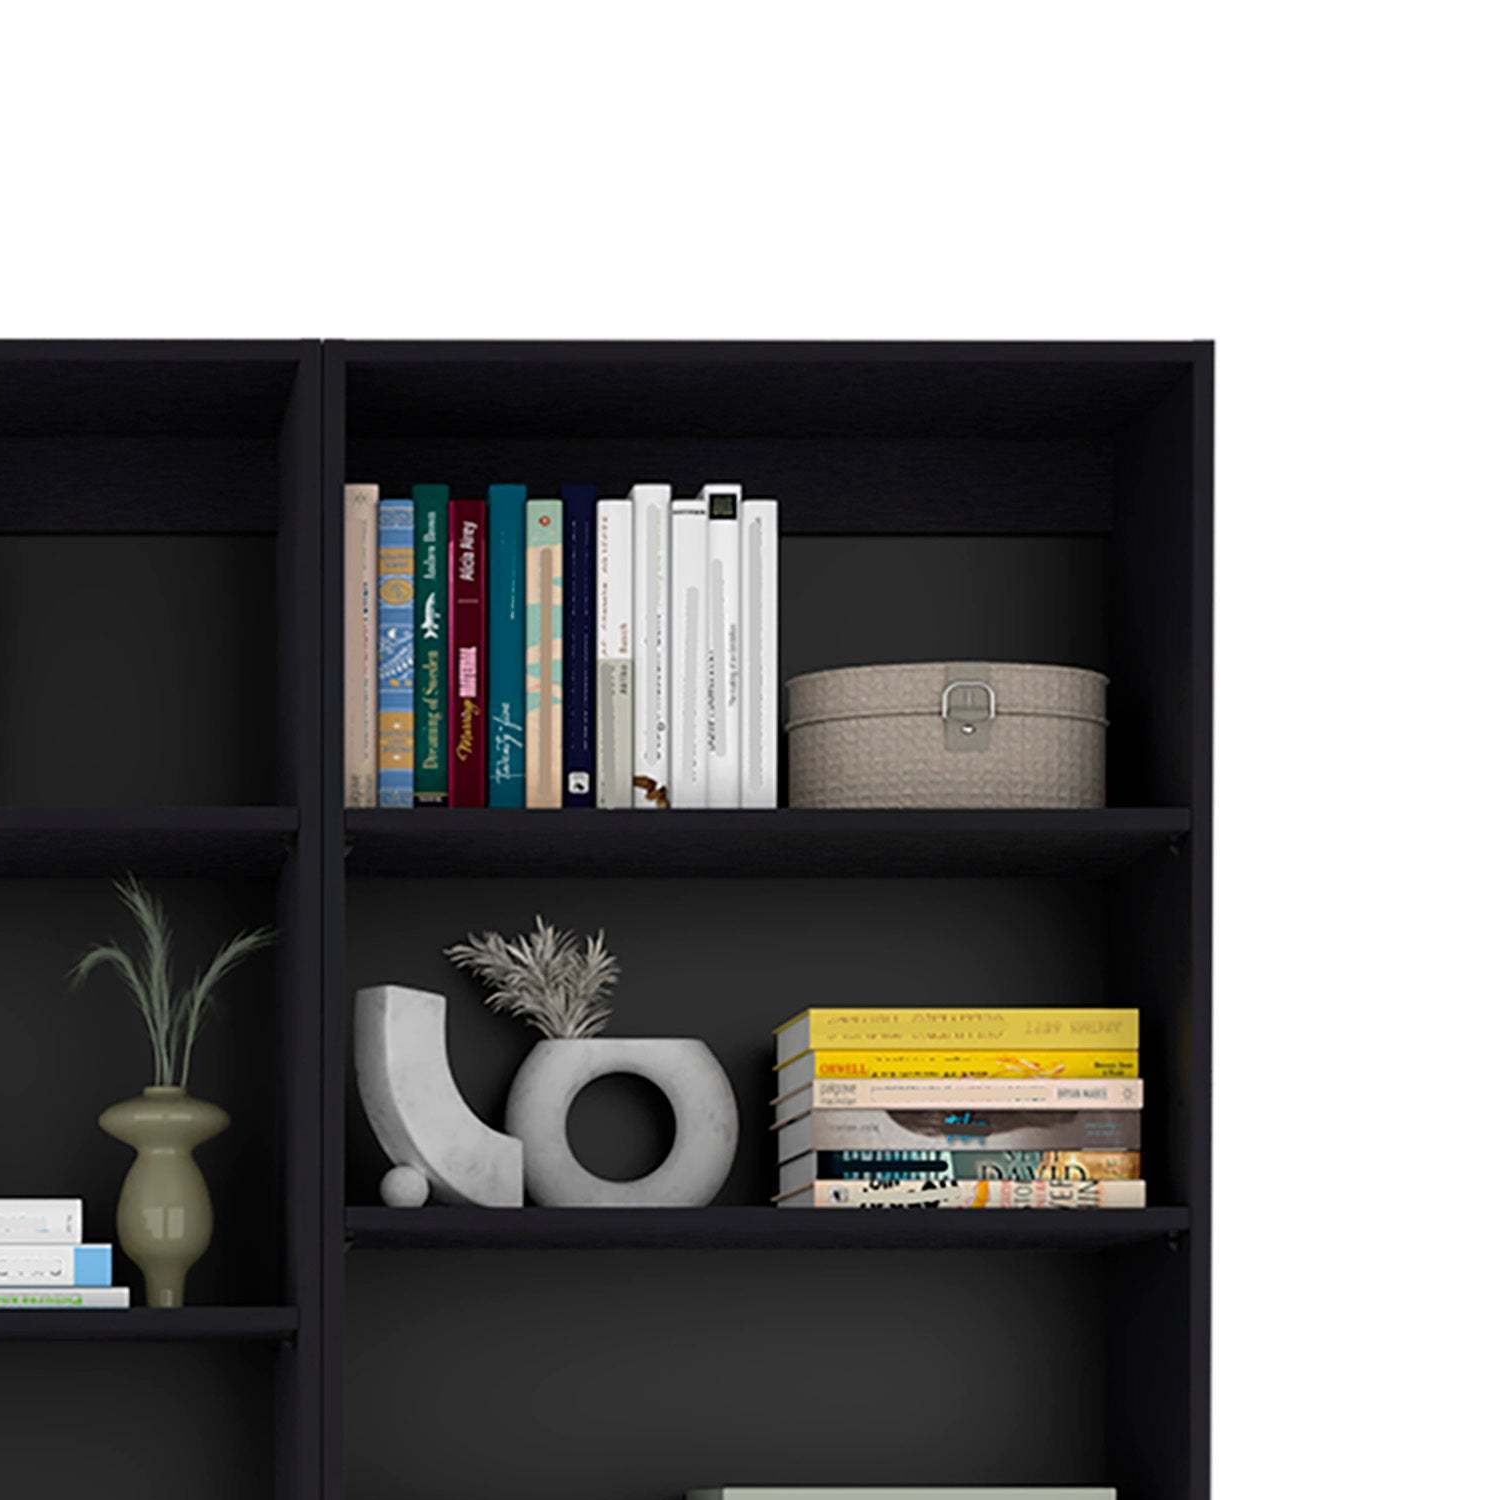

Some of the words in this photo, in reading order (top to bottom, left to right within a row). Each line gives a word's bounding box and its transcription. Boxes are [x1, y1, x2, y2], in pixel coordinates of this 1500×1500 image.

[458, 552, 476, 582] Alicia
[422, 650, 438, 696] Sweden
[422, 697, 439, 711] of
[422, 712, 442, 769] Dreaming
